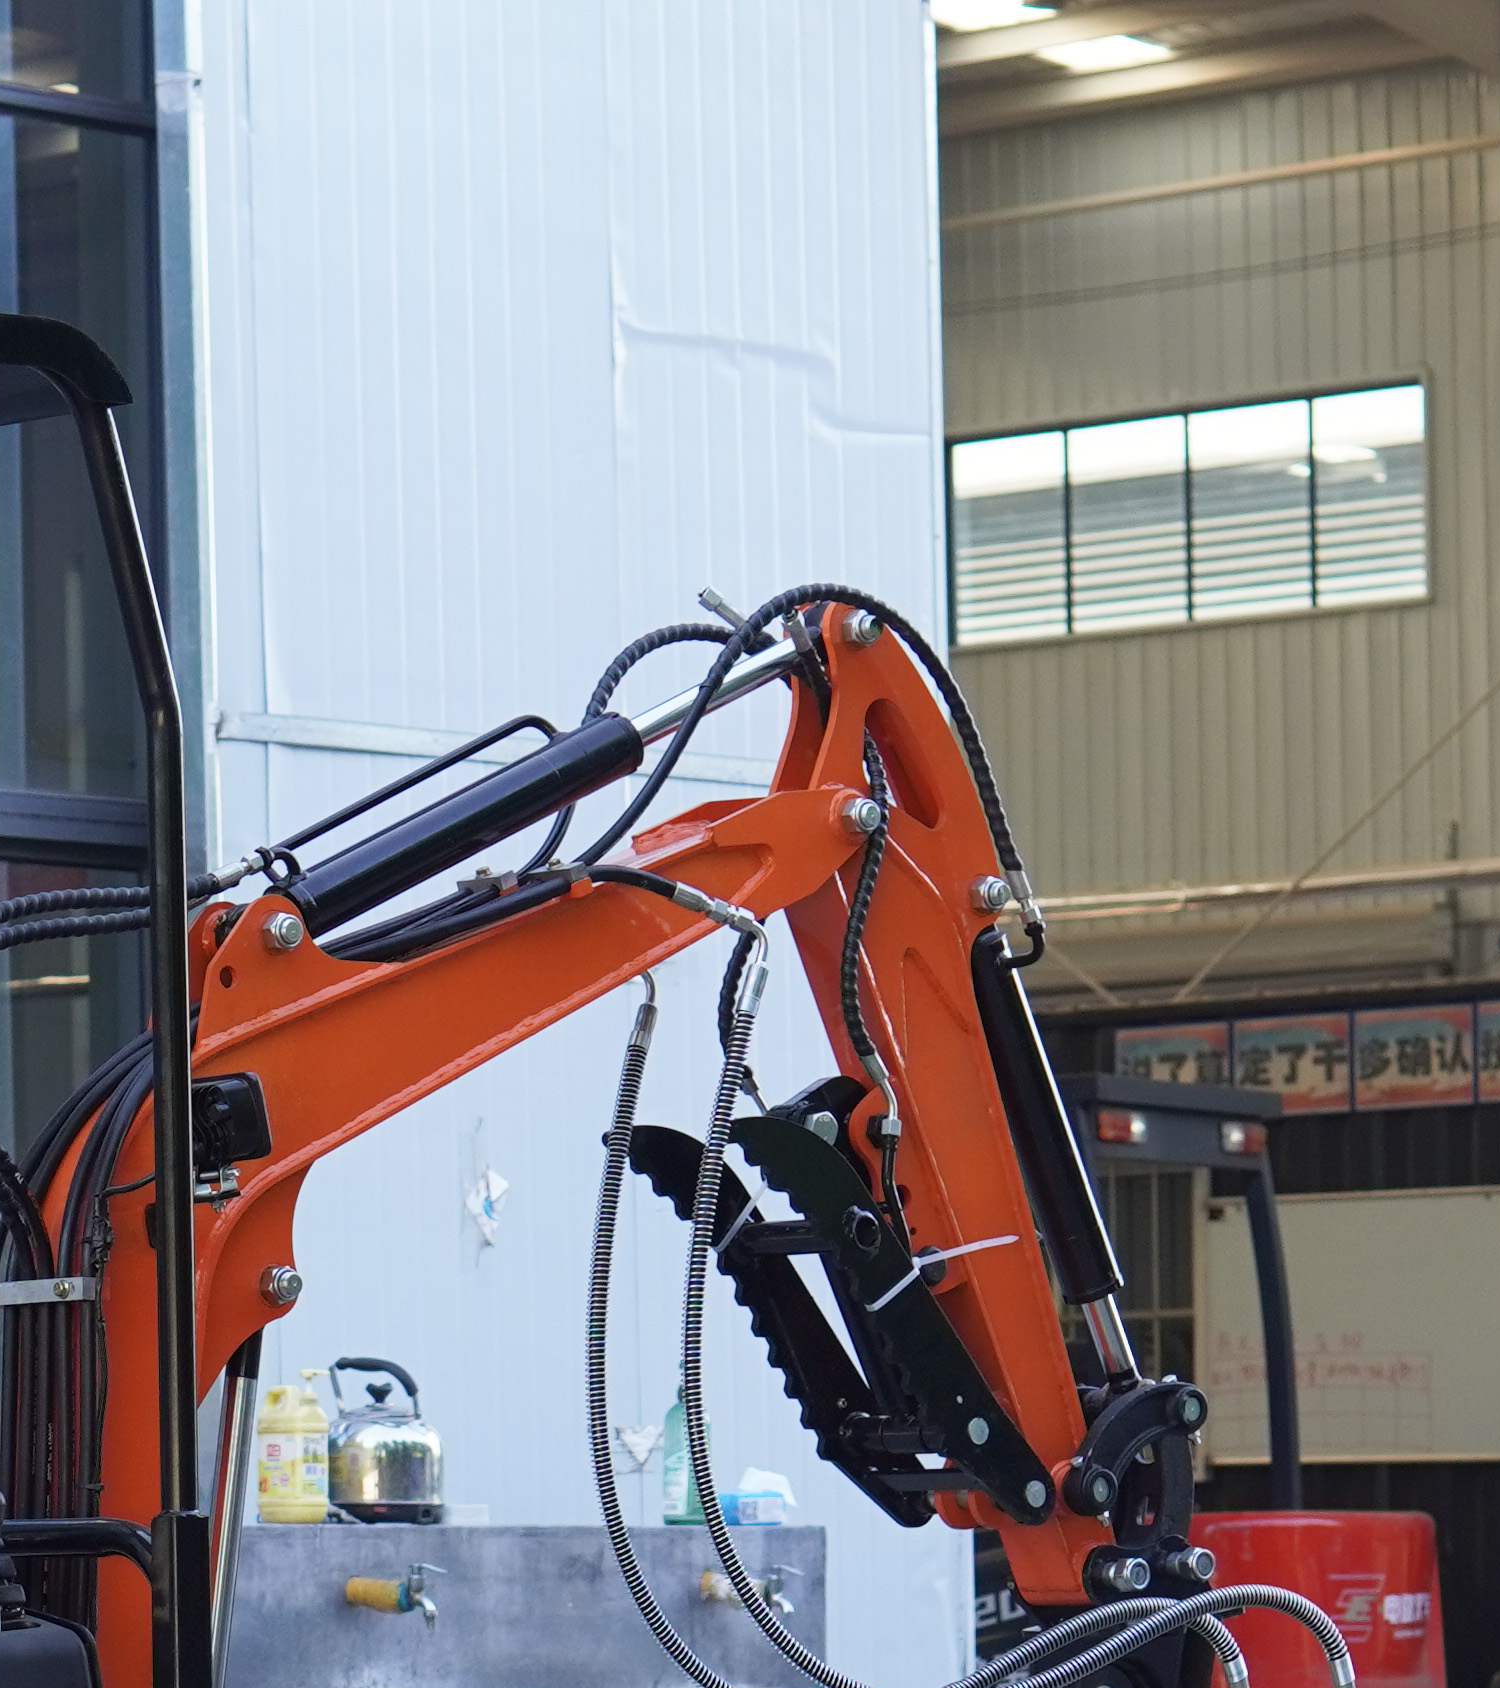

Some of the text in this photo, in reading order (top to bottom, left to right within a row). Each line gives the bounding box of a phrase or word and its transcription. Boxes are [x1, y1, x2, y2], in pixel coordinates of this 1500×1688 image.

[1239, 1039, 1348, 1086] 定了干
[1357, 1029, 1470, 1080] 多确认
